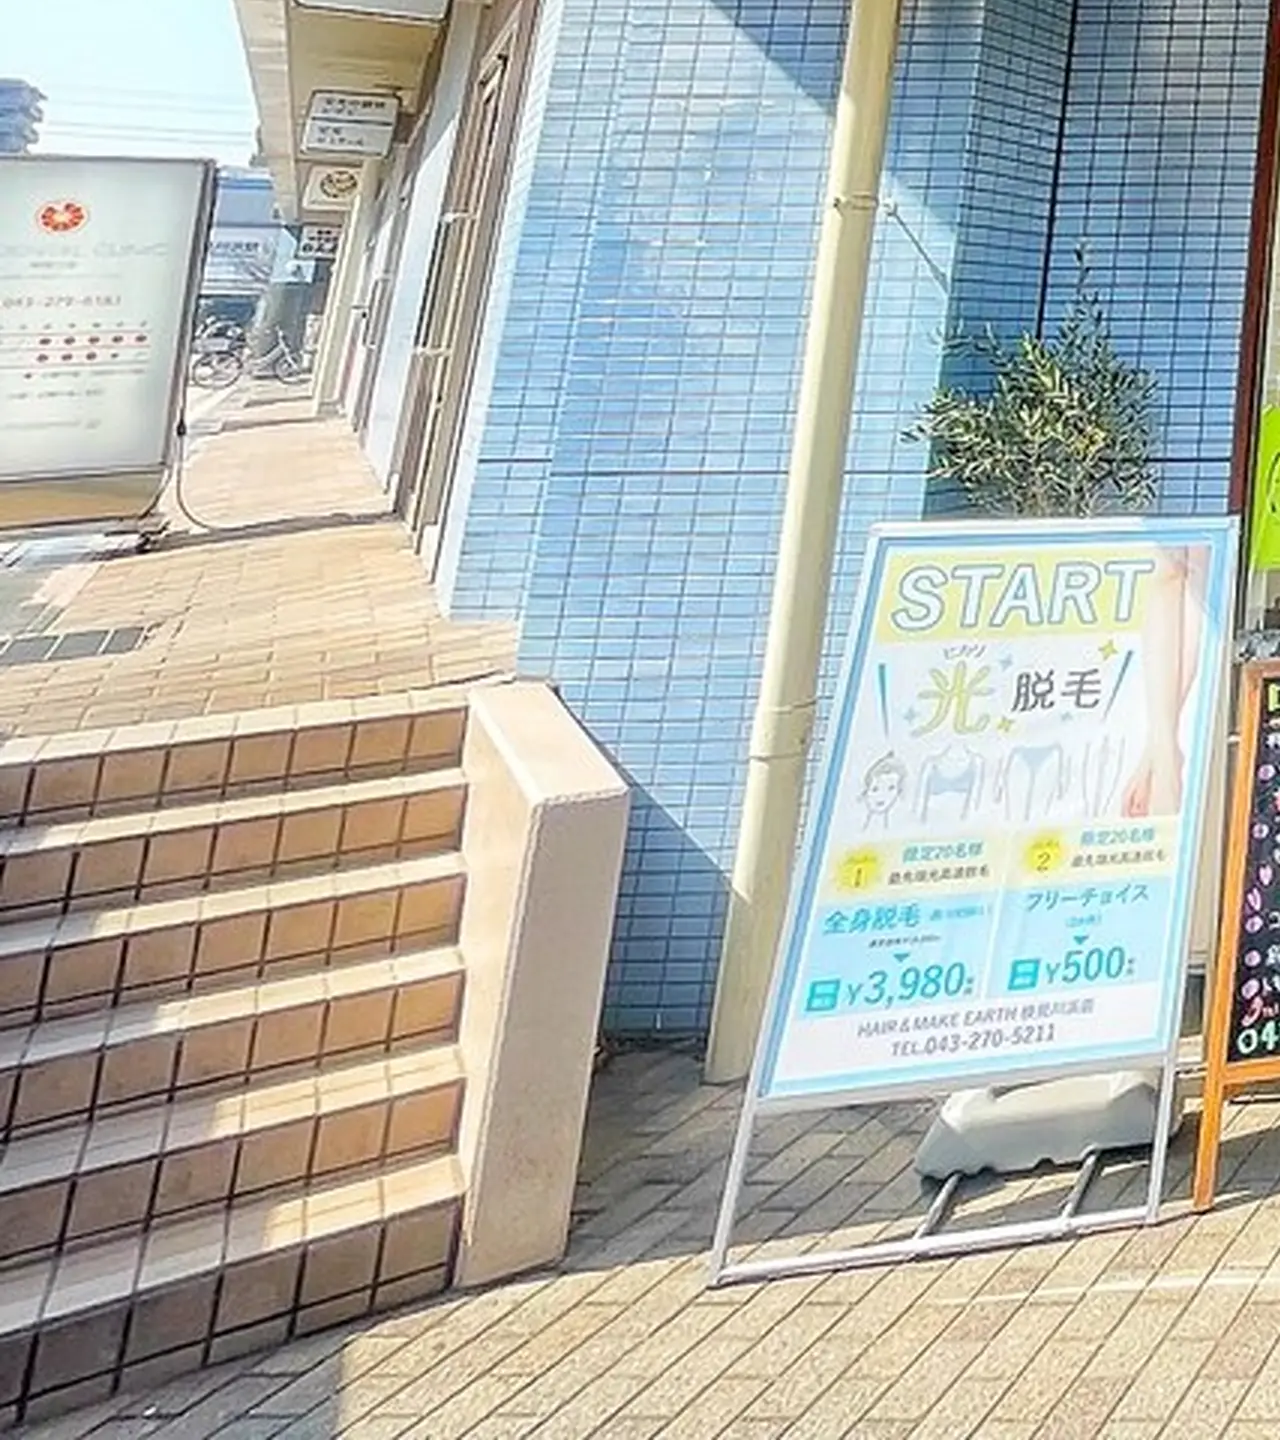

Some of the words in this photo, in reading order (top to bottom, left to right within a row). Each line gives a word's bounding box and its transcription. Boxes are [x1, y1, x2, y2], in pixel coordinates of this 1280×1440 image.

[890, 561, 1155, 633] START
[911, 660, 995, 738] 光
[1010, 668, 1102, 712] 脱毛
[822, 902, 921, 936] 全身脱毛
[1027, 884, 1150, 912] フリーチョイス
